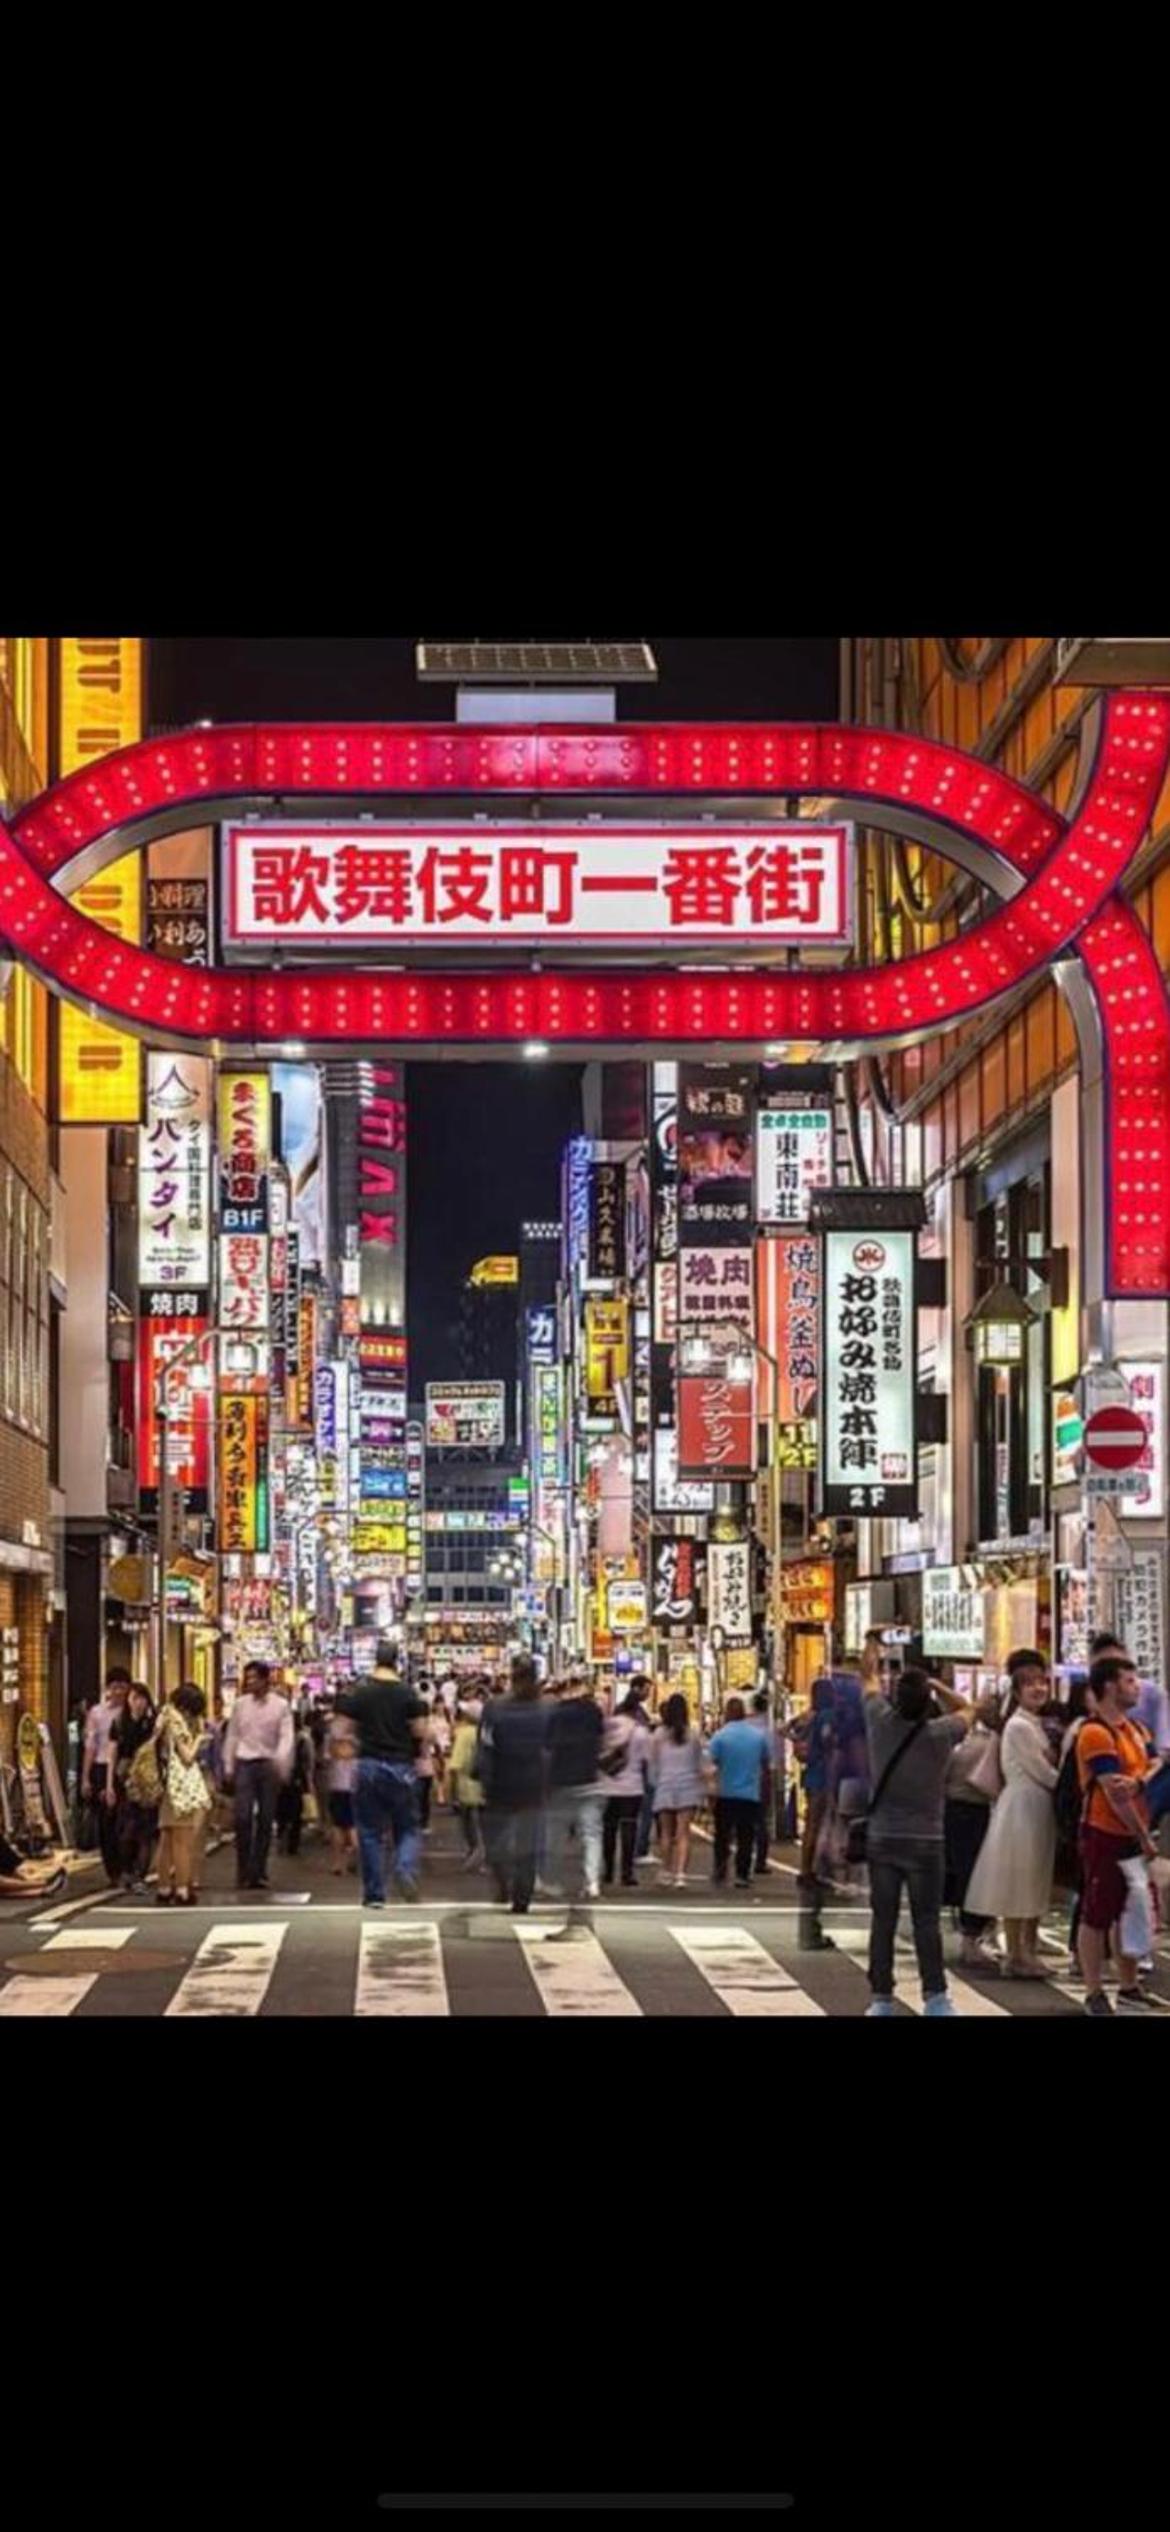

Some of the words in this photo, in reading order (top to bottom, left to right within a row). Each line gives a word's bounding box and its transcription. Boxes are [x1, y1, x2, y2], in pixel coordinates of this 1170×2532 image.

[251, 845, 824, 925] 歌舞伎町一番街
[775, 1130, 799, 1219] 東南荘
[223, 1209, 264, 1227] B1F
[159, 1265, 188, 1280] 3F
[150, 1292, 199, 1316] 焼肉
[838, 1273, 878, 1471] お好み焼本陣
[849, 1487, 886, 1508] 2F
